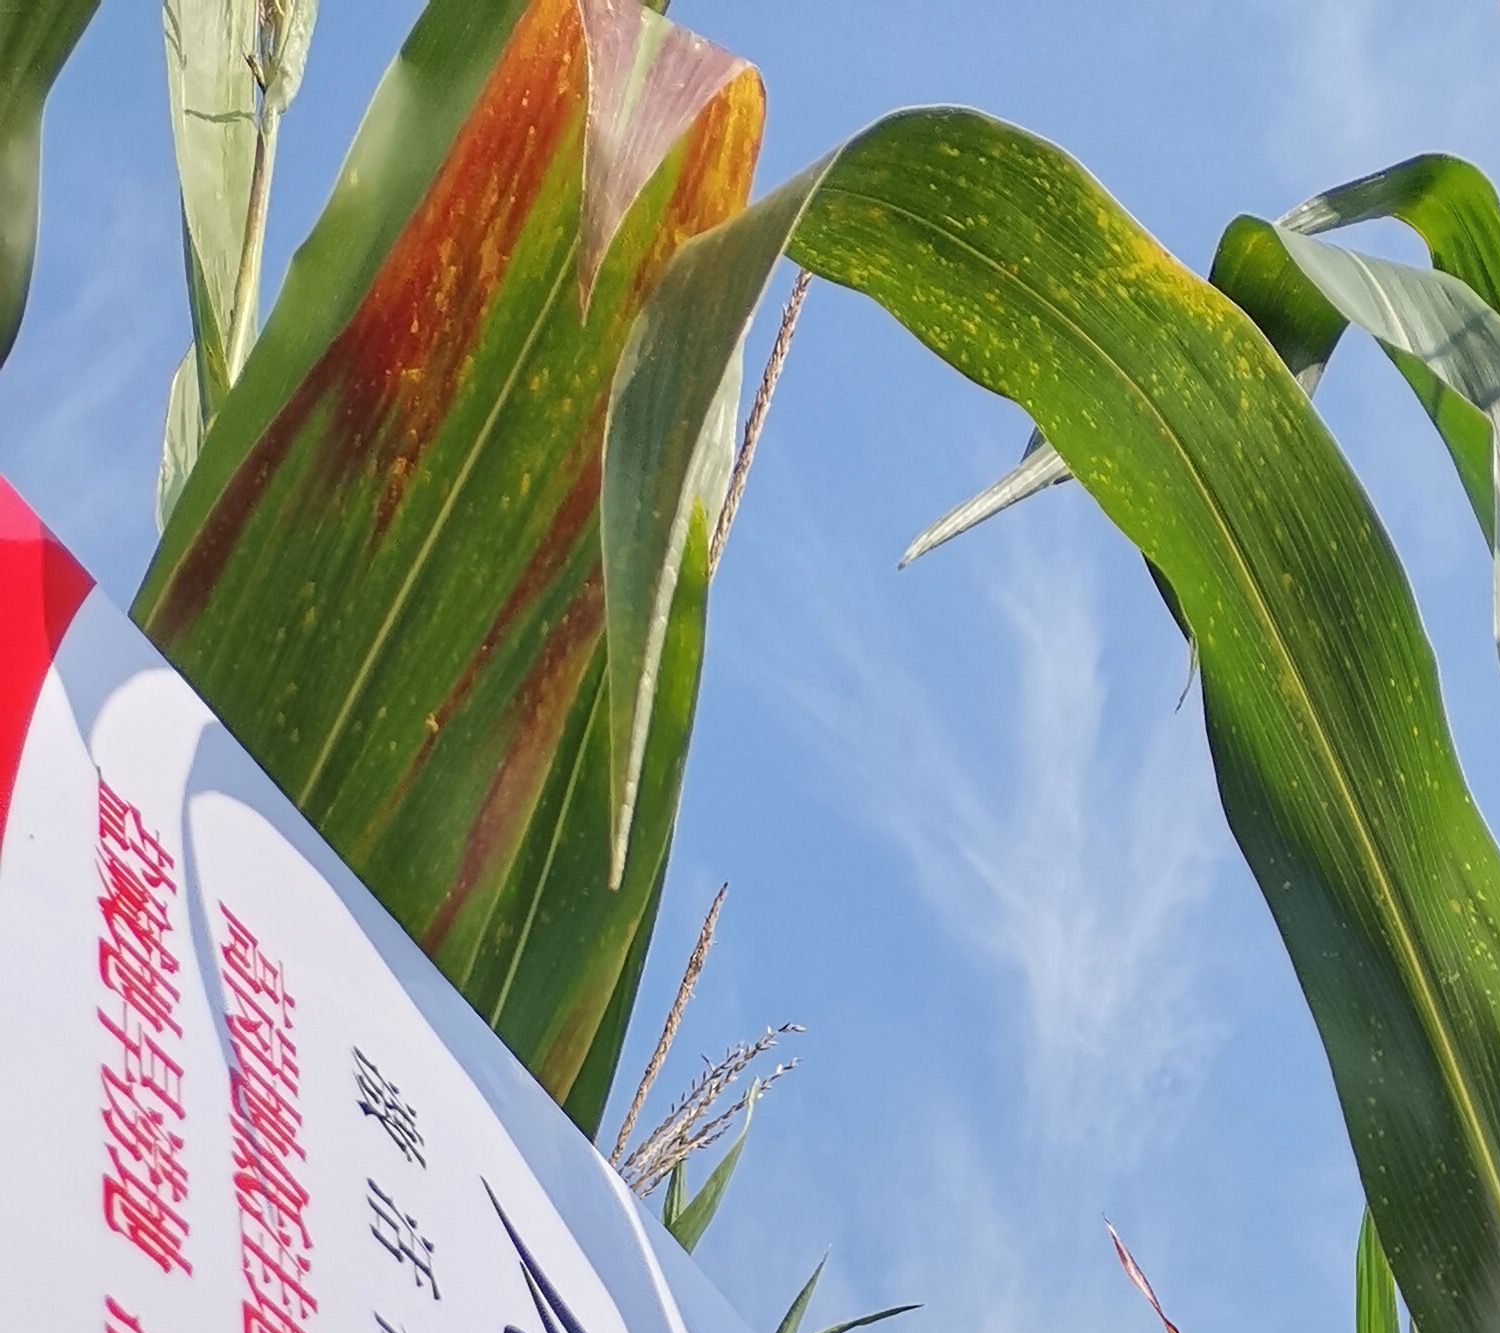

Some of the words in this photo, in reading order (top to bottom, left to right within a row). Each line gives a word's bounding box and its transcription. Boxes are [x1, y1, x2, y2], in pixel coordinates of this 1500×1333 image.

[95, 766, 193, 1279] 盐碱地旱涝地
